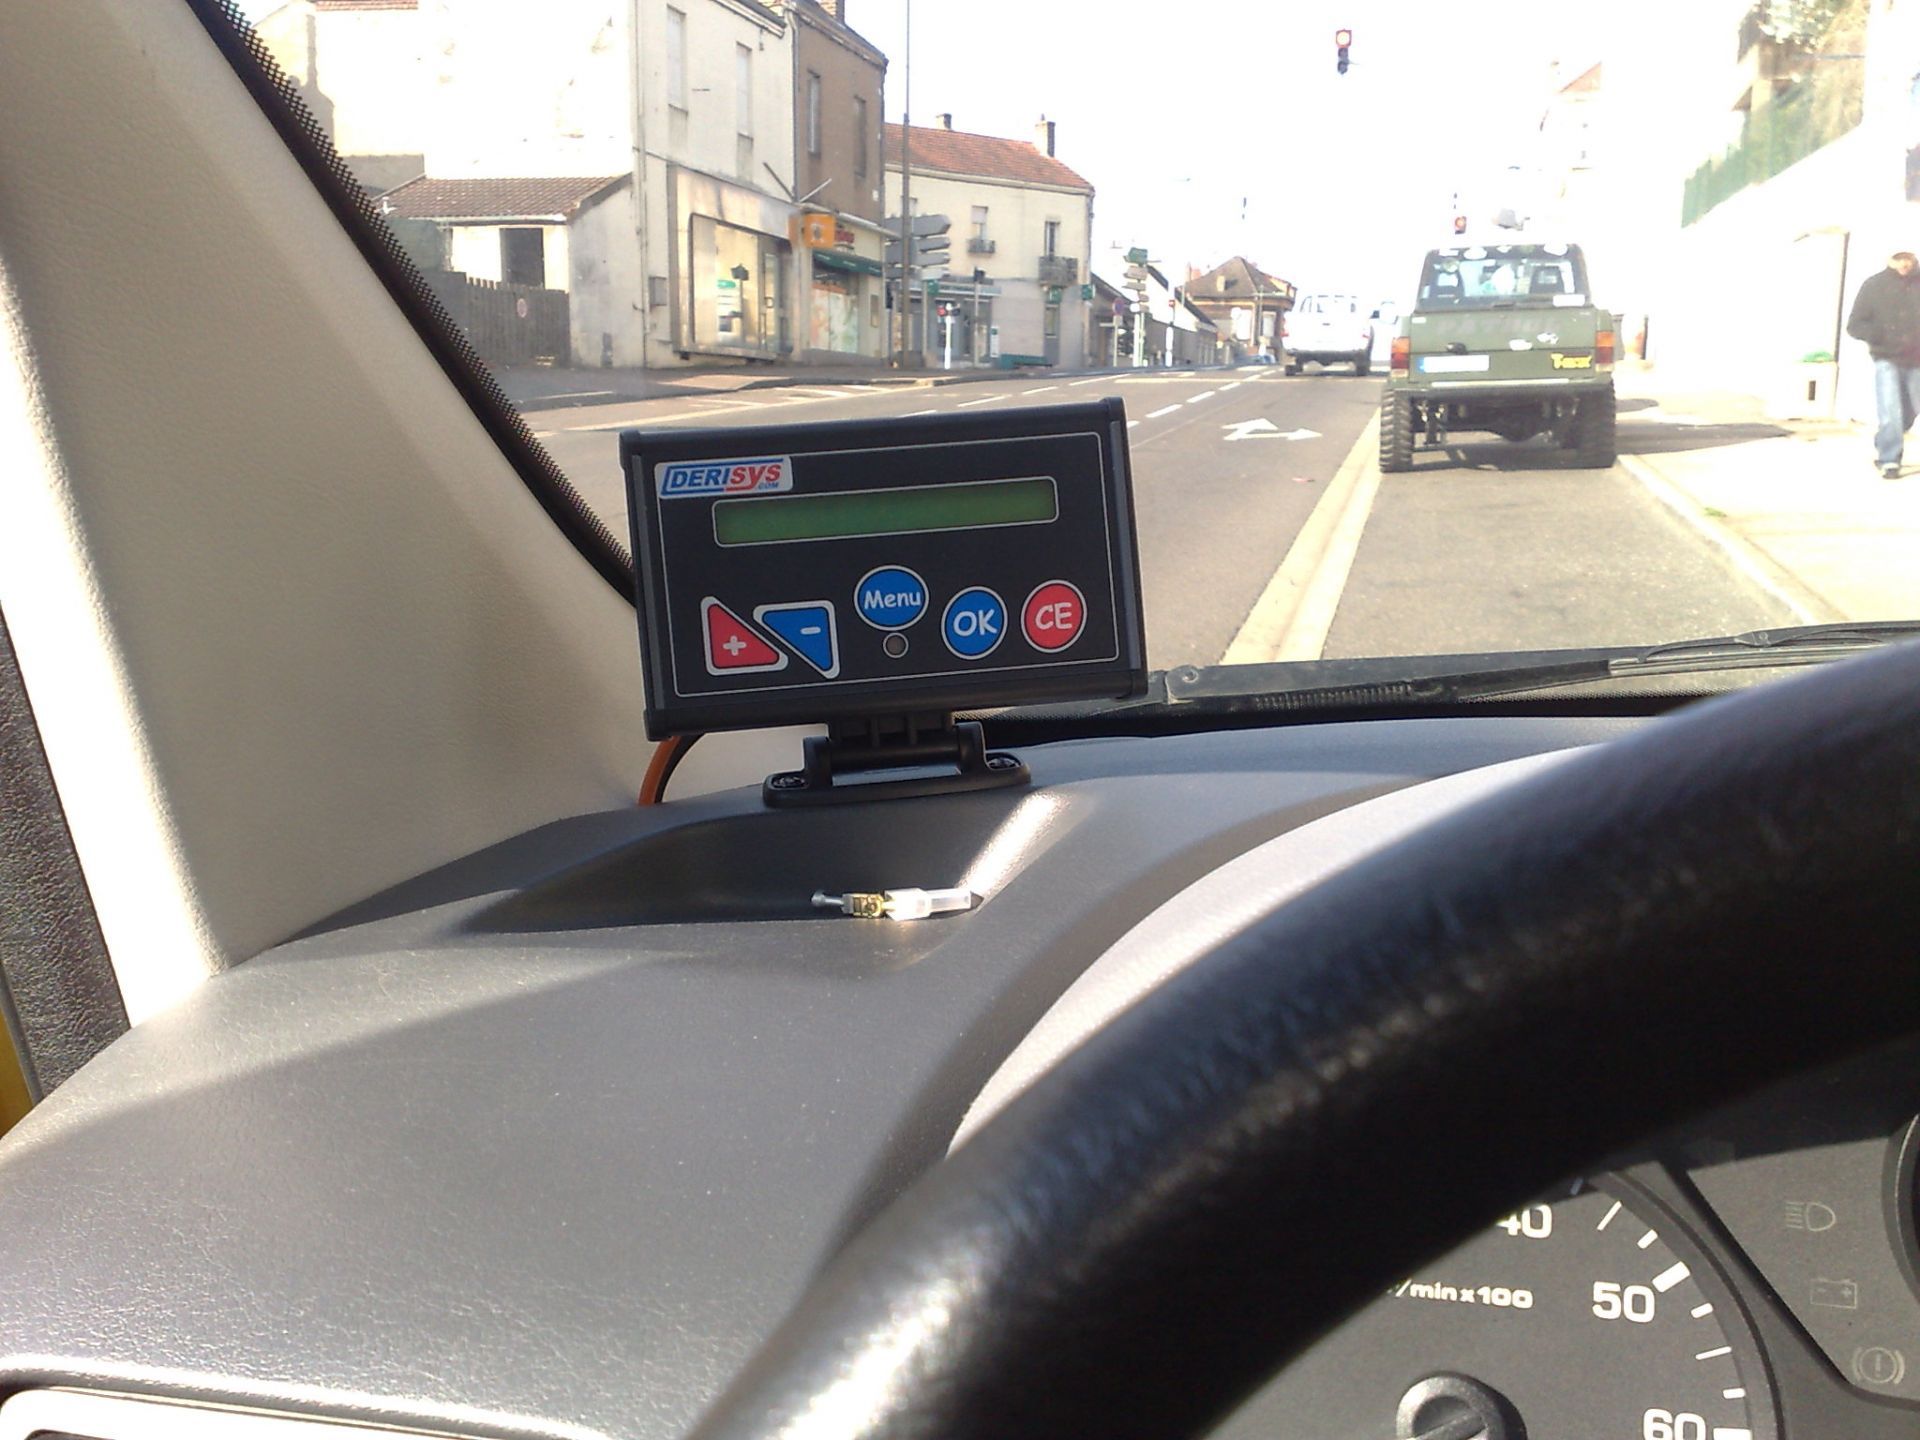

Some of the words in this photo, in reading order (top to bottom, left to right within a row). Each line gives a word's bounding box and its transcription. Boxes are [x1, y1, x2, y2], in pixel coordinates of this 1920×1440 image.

[864, 589, 921, 610] Menu
[953, 607, 998, 637] OK
[1035, 602, 1073, 630] CE
[1592, 1281, 1655, 1323] 50
[1643, 1408, 1706, 1440] 60
